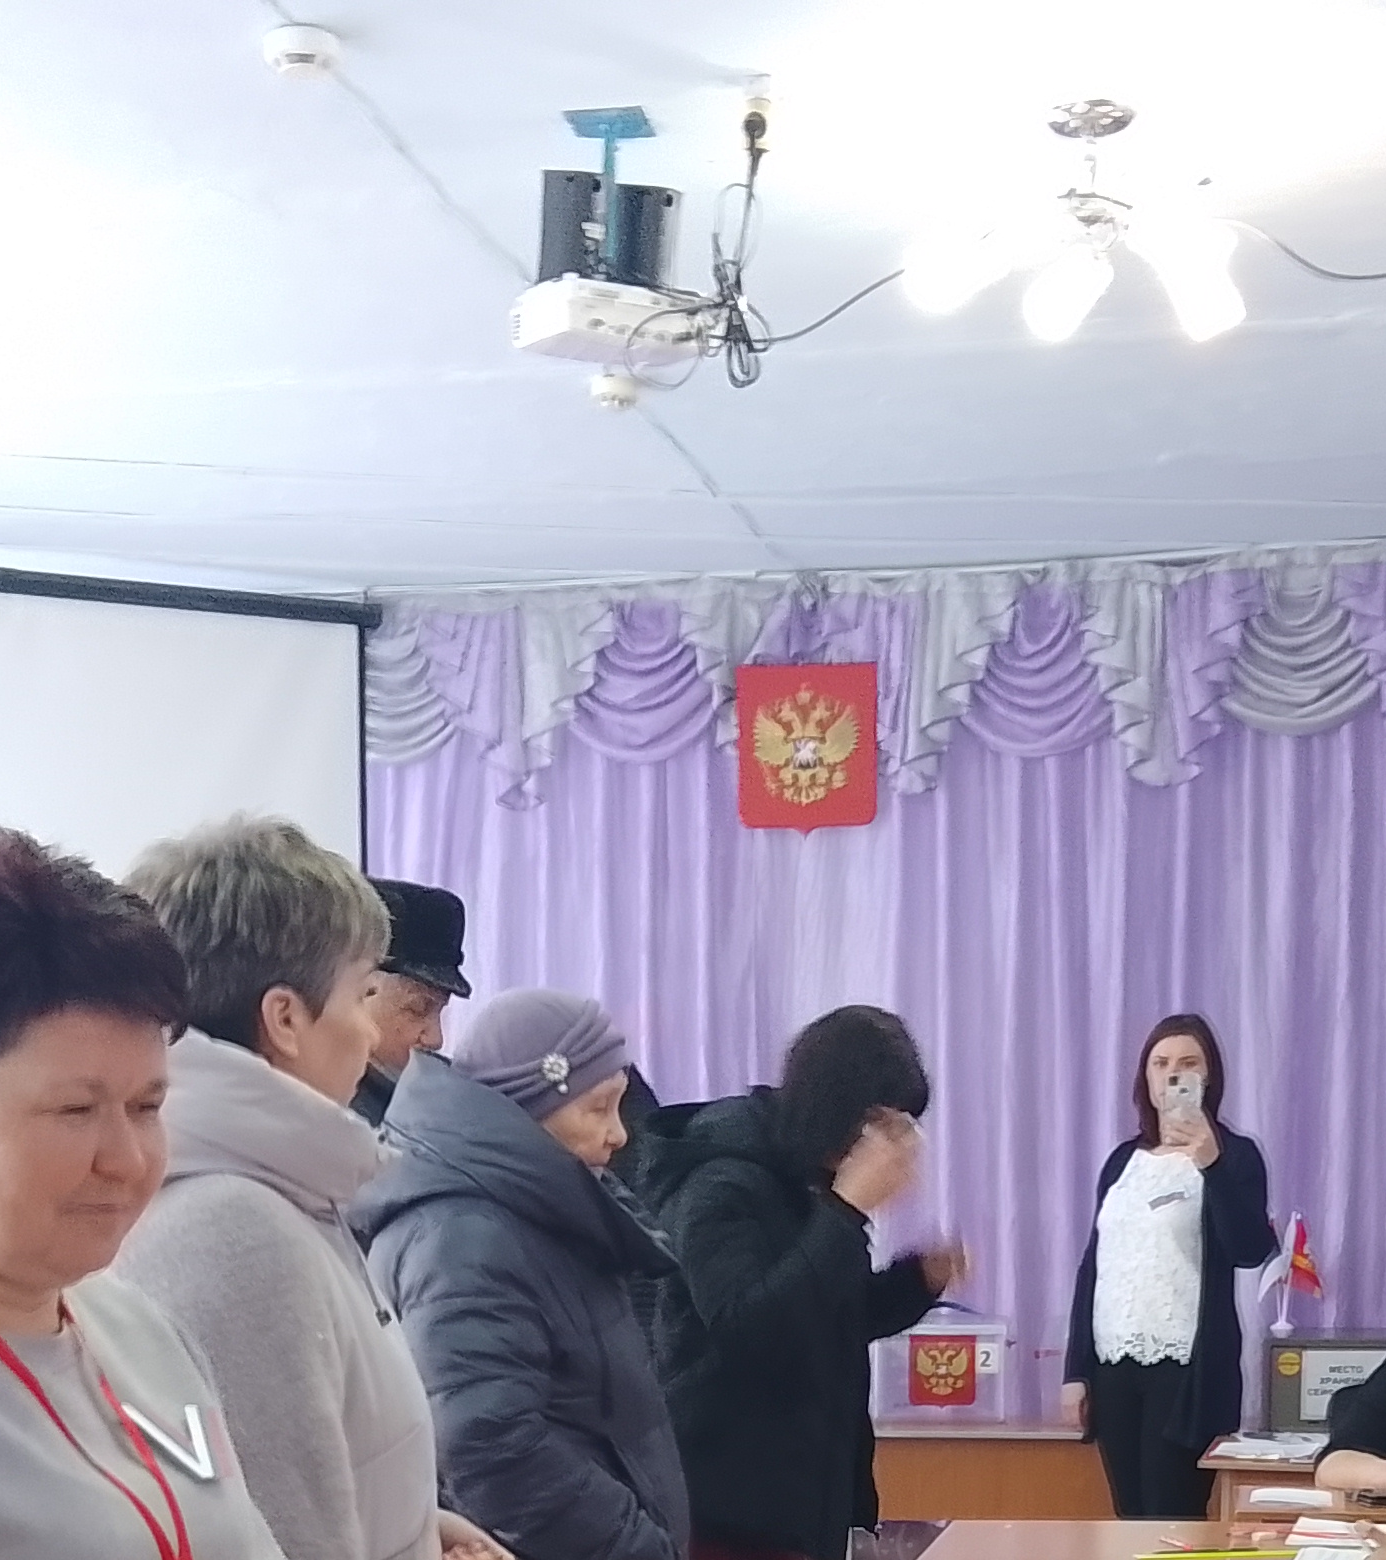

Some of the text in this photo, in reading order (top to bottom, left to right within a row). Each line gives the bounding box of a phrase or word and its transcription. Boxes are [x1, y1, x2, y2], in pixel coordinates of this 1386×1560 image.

[979, 1350, 992, 1368] 2
[1328, 1365, 1364, 1374] МЕСТО
[1319, 1377, 1366, 1385] ХРАНЕНИ
